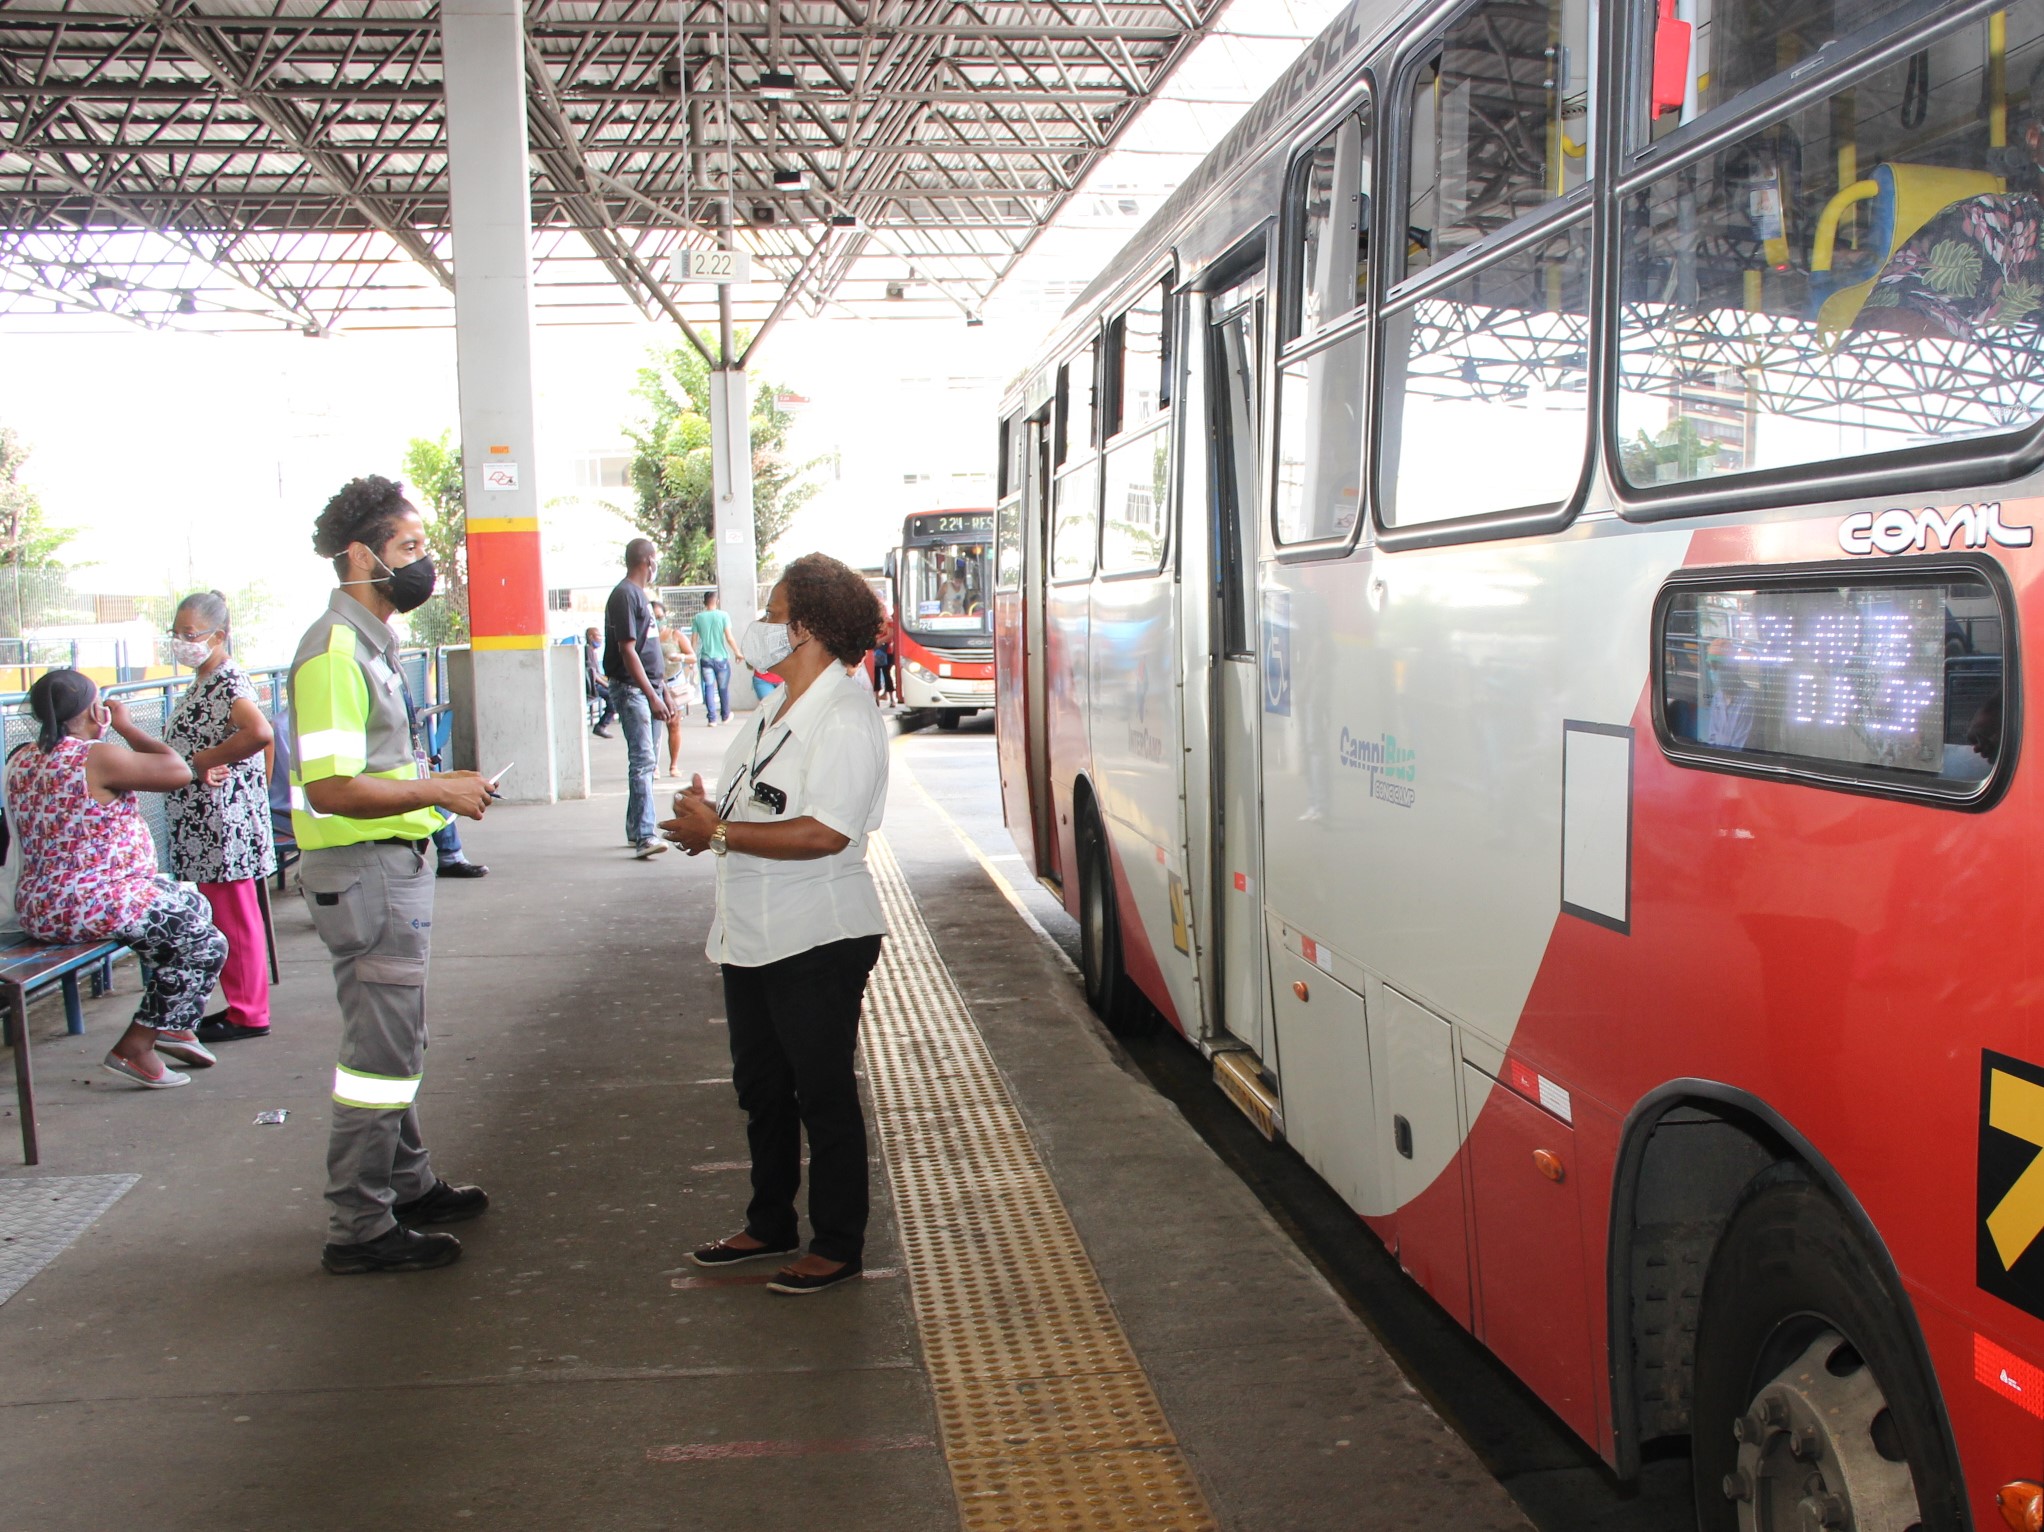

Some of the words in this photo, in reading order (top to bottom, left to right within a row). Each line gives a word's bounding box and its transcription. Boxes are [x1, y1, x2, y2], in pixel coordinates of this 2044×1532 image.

[695, 254, 731, 275] 2.22
[939, 516, 963, 532] 2.24
[1838, 502, 2034, 556] COMIL
[1340, 725, 1417, 798] CampiBus
